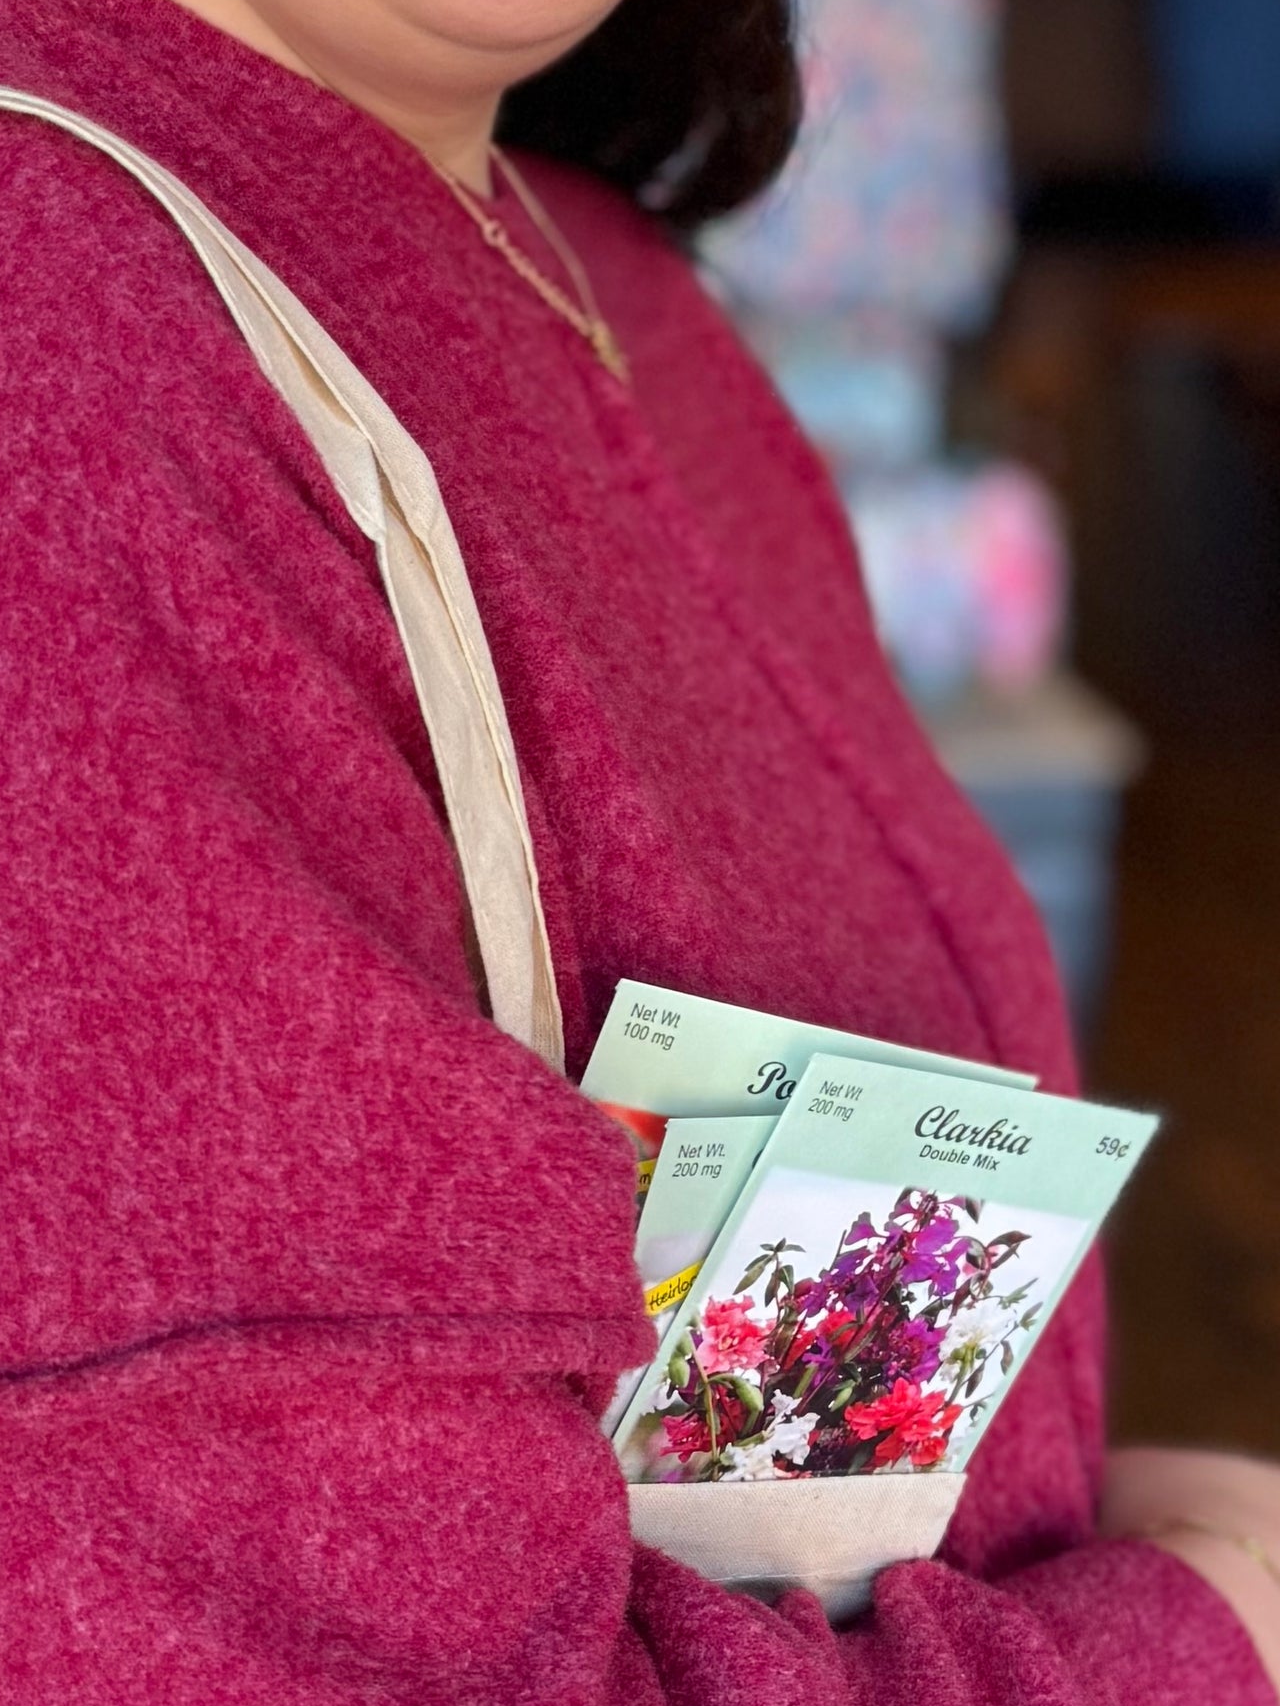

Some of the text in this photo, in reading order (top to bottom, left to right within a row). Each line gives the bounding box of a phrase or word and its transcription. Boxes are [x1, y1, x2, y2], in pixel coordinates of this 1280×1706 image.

[630, 1003, 658, 1022] Net
[623, 1021, 676, 1051] 100 mg
[819, 1080, 844, 1098] Net
[807, 1098, 854, 1122] 200 mg
[914, 1105, 1033, 1156] Clarkia
[677, 1144, 701, 1159] Net
[919, 1144, 1001, 1172] Double Mix
[1095, 1135, 1132, 1162] 59¢
[672, 1162, 723, 1179] 200 mg
